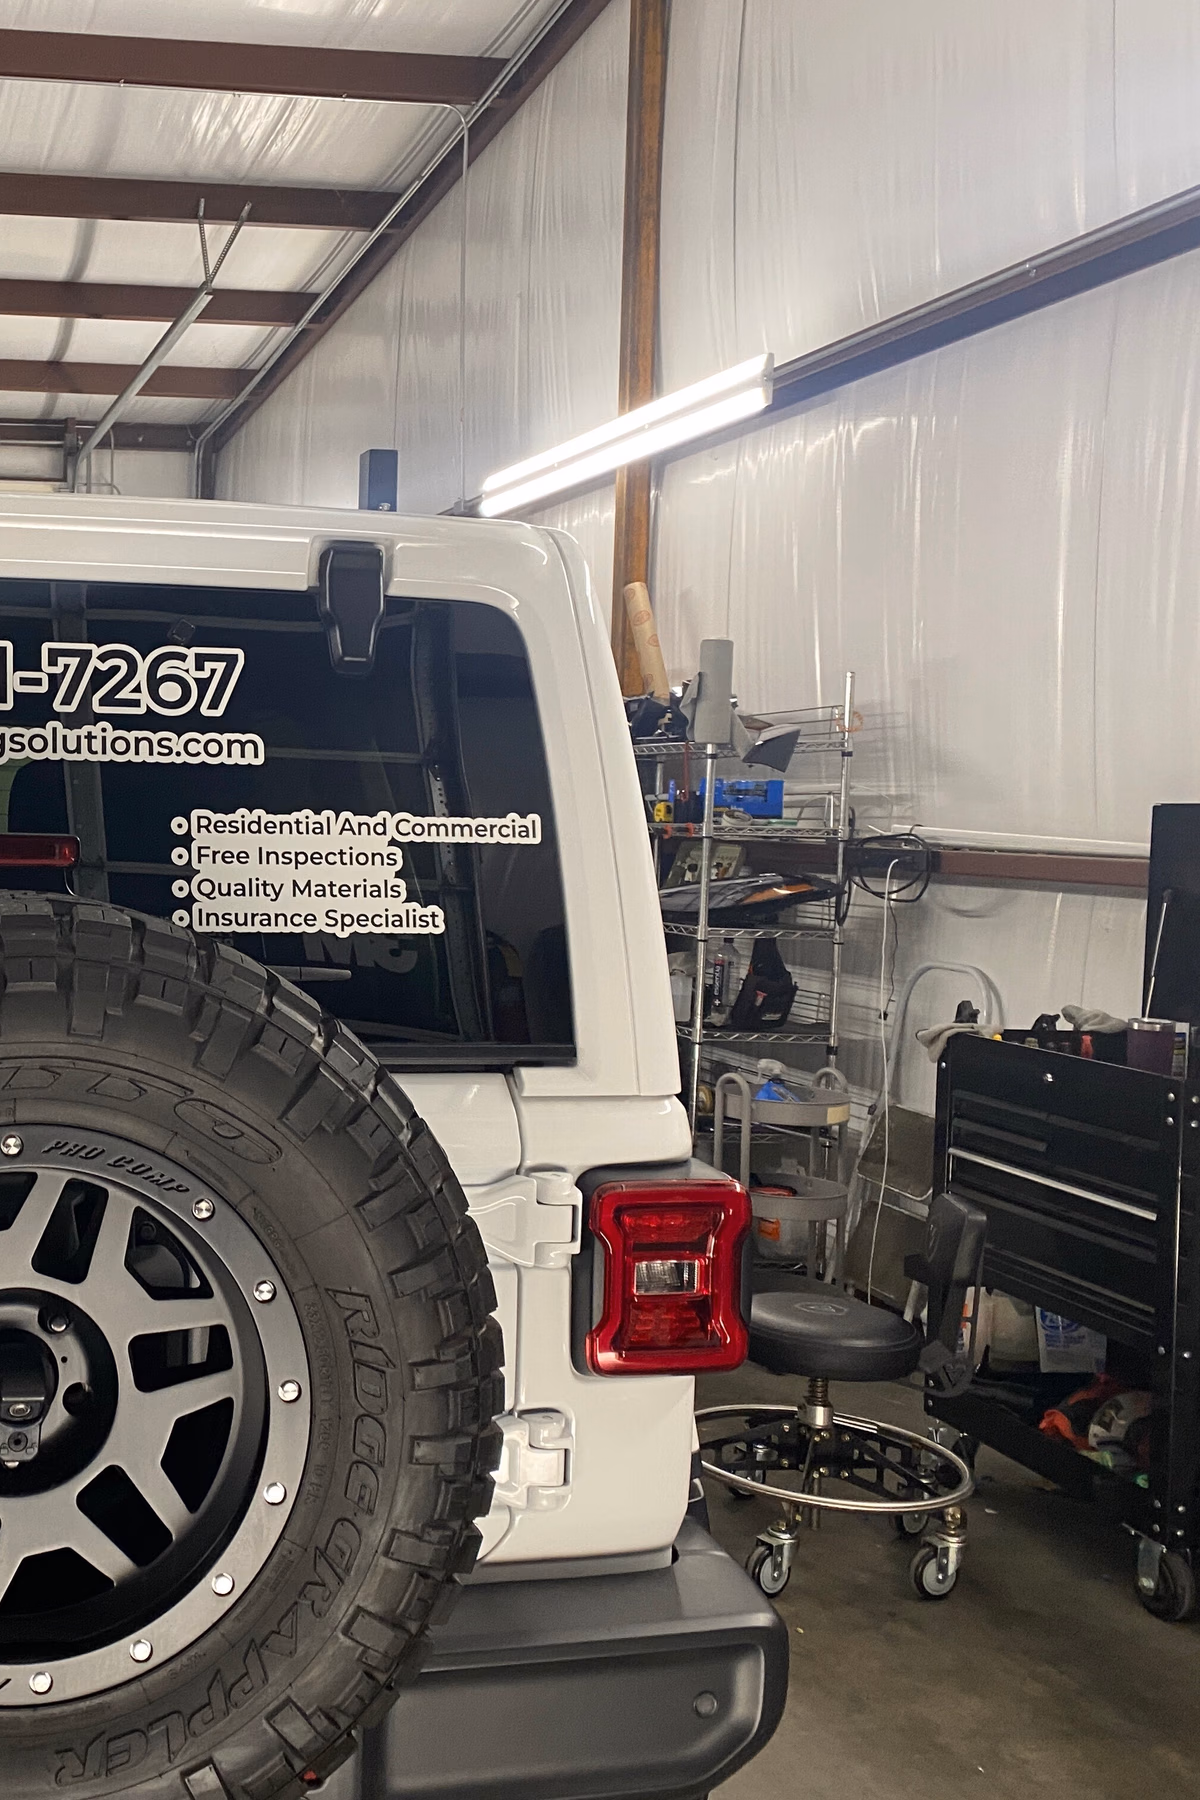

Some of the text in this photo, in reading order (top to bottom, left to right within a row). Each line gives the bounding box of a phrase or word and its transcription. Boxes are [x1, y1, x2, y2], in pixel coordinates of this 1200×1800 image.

[196, 815, 537, 839] Residential And Commercial
[197, 846, 398, 872] Free Inspections
[196, 879, 402, 901] Quality Materials
[197, 907, 440, 932] Insurance Specialist
[41, 1140, 190, 1194] PRO COMP
[54, 1287, 396, 1788] RIDGE GRAPPLER
